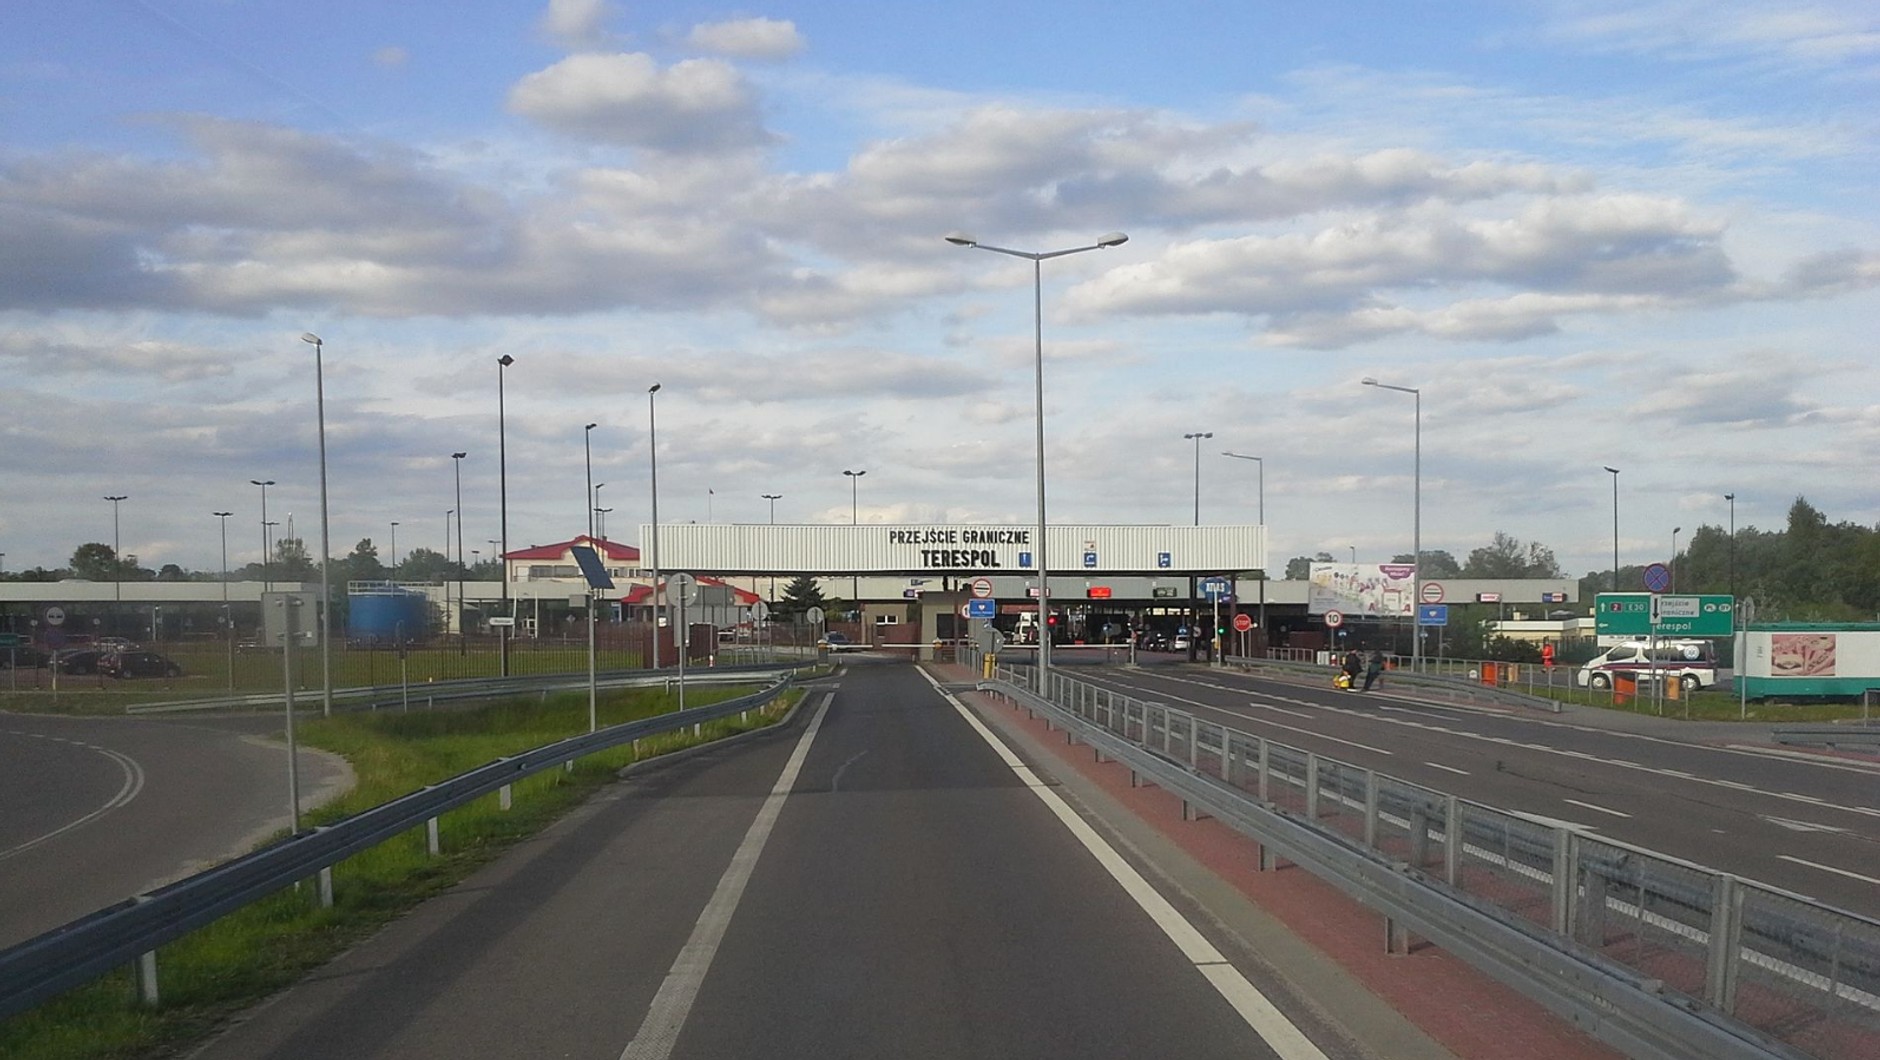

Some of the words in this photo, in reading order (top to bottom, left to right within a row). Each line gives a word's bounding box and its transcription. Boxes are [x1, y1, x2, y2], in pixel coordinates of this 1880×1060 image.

[890, 529, 956, 544] PRZEJŚCIE
[963, 530, 1030, 544] GRANICZNE
[921, 549, 1001, 568] TERESPOL
[1235, 619, 1250, 627] STOP
[1328, 614, 1339, 624] 10
[1656, 621, 1692, 632] erespol
